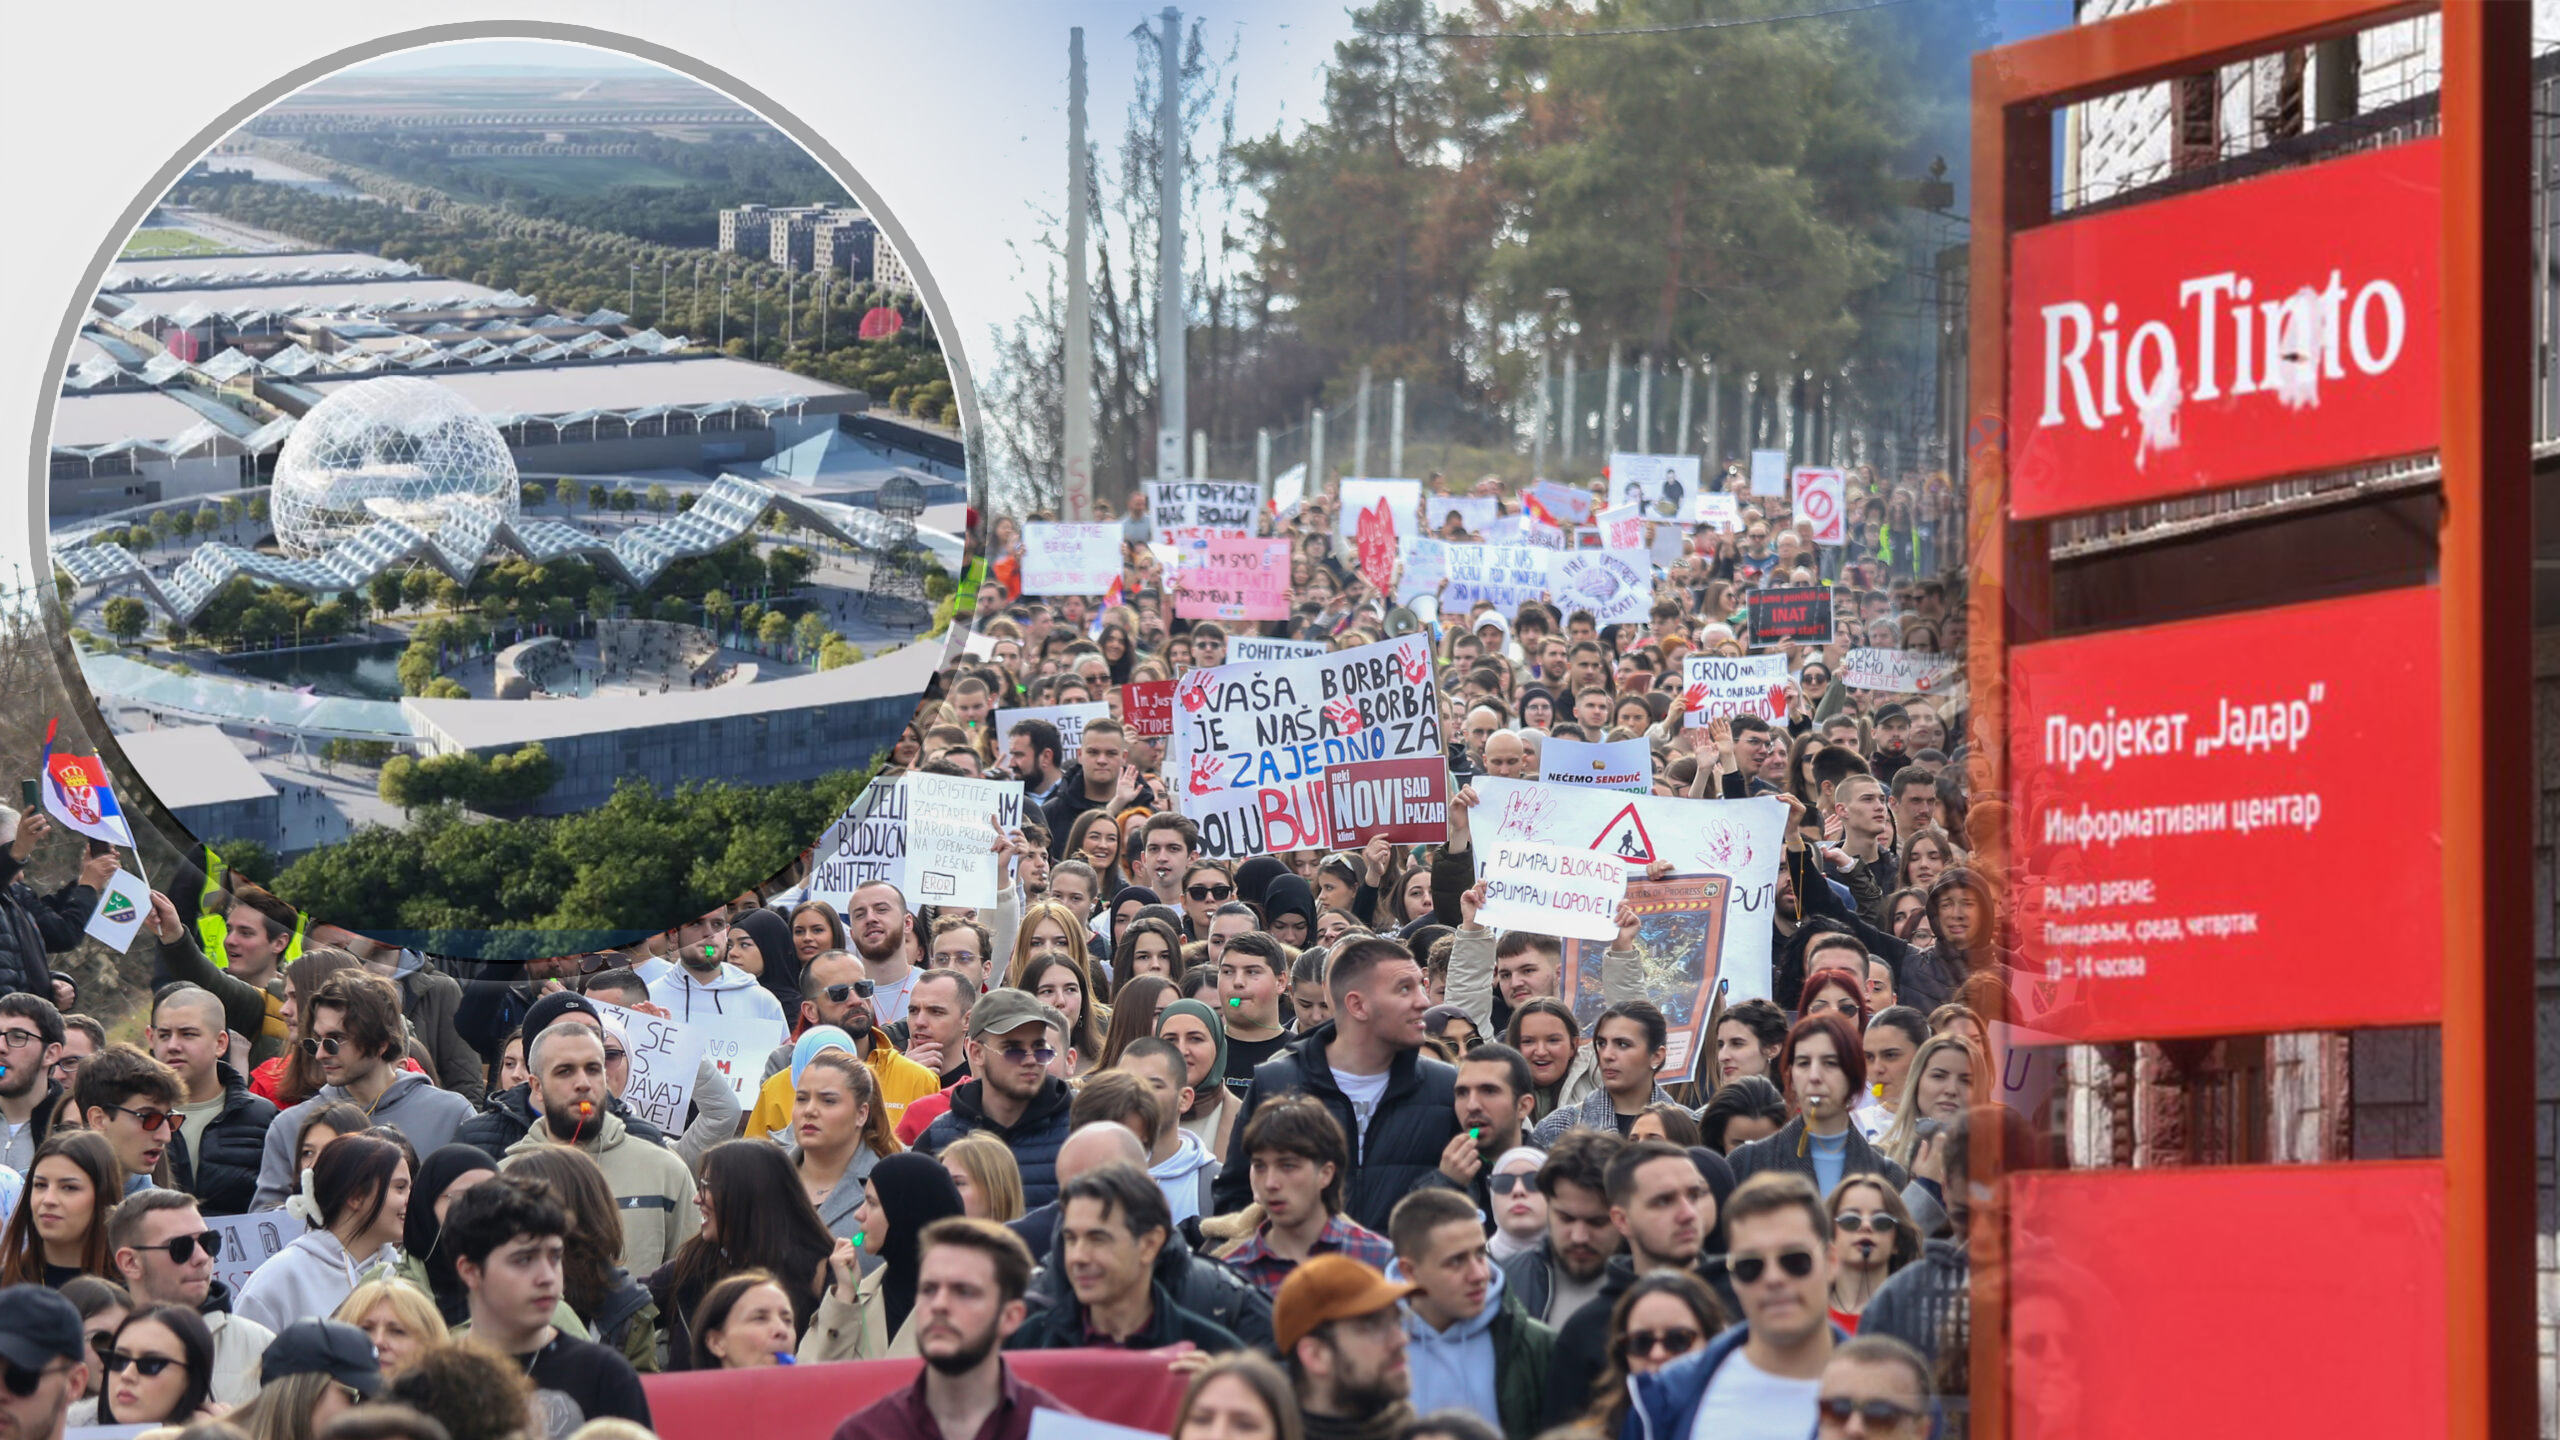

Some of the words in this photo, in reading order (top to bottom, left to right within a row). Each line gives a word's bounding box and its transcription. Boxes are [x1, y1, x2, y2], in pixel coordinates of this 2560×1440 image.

[1772, 606, 1807, 623] INAT
[1197, 671, 1296, 713] VAŠA
[1321, 653, 1404, 700] BORBA
[1692, 662, 1738, 681] CRNO
[1740, 665, 1755, 676] NA
[1892, 664, 1913, 678] NA
[1193, 714, 1228, 753] JE
[1256, 703, 1339, 747] NAŠA
[1359, 681, 1437, 729] BORBA
[1699, 711, 1708, 725] U
[1711, 698, 1771, 722] CRVENO
[1227, 727, 1384, 788] ZAJEDNO
[1391, 716, 1440, 754] ZA
[2045, 706, 2188, 774] Пројекат
[917, 776, 991, 801] KORISTITE
[1332, 769, 1350, 783] neki
[1548, 772, 1593, 783] NEĆEMO
[1595, 771, 1640, 784] SENDVIČ
[1332, 778, 1404, 830] NOVI
[1404, 776, 1430, 798] SAD
[1405, 802, 1445, 824] PAZAR
[914, 819, 954, 837] NAROD
[2044, 800, 2226, 851] Информативни
[2232, 793, 2321, 834] центар
[914, 838, 928, 851] NA
[1499, 850, 1557, 873] PUMPAJ
[1560, 856, 1622, 884] BLOKADE
[924, 875, 951, 890] EROR
[2044, 884, 2097, 913] РАДНО
[2100, 879, 2155, 905] ВРЕМЕ:
[2186, 913, 2258, 938] четвртак
[2076, 956, 2092, 979] 14
[2095, 956, 2146, 978] часова
[641, 1021, 678, 1054] SE
